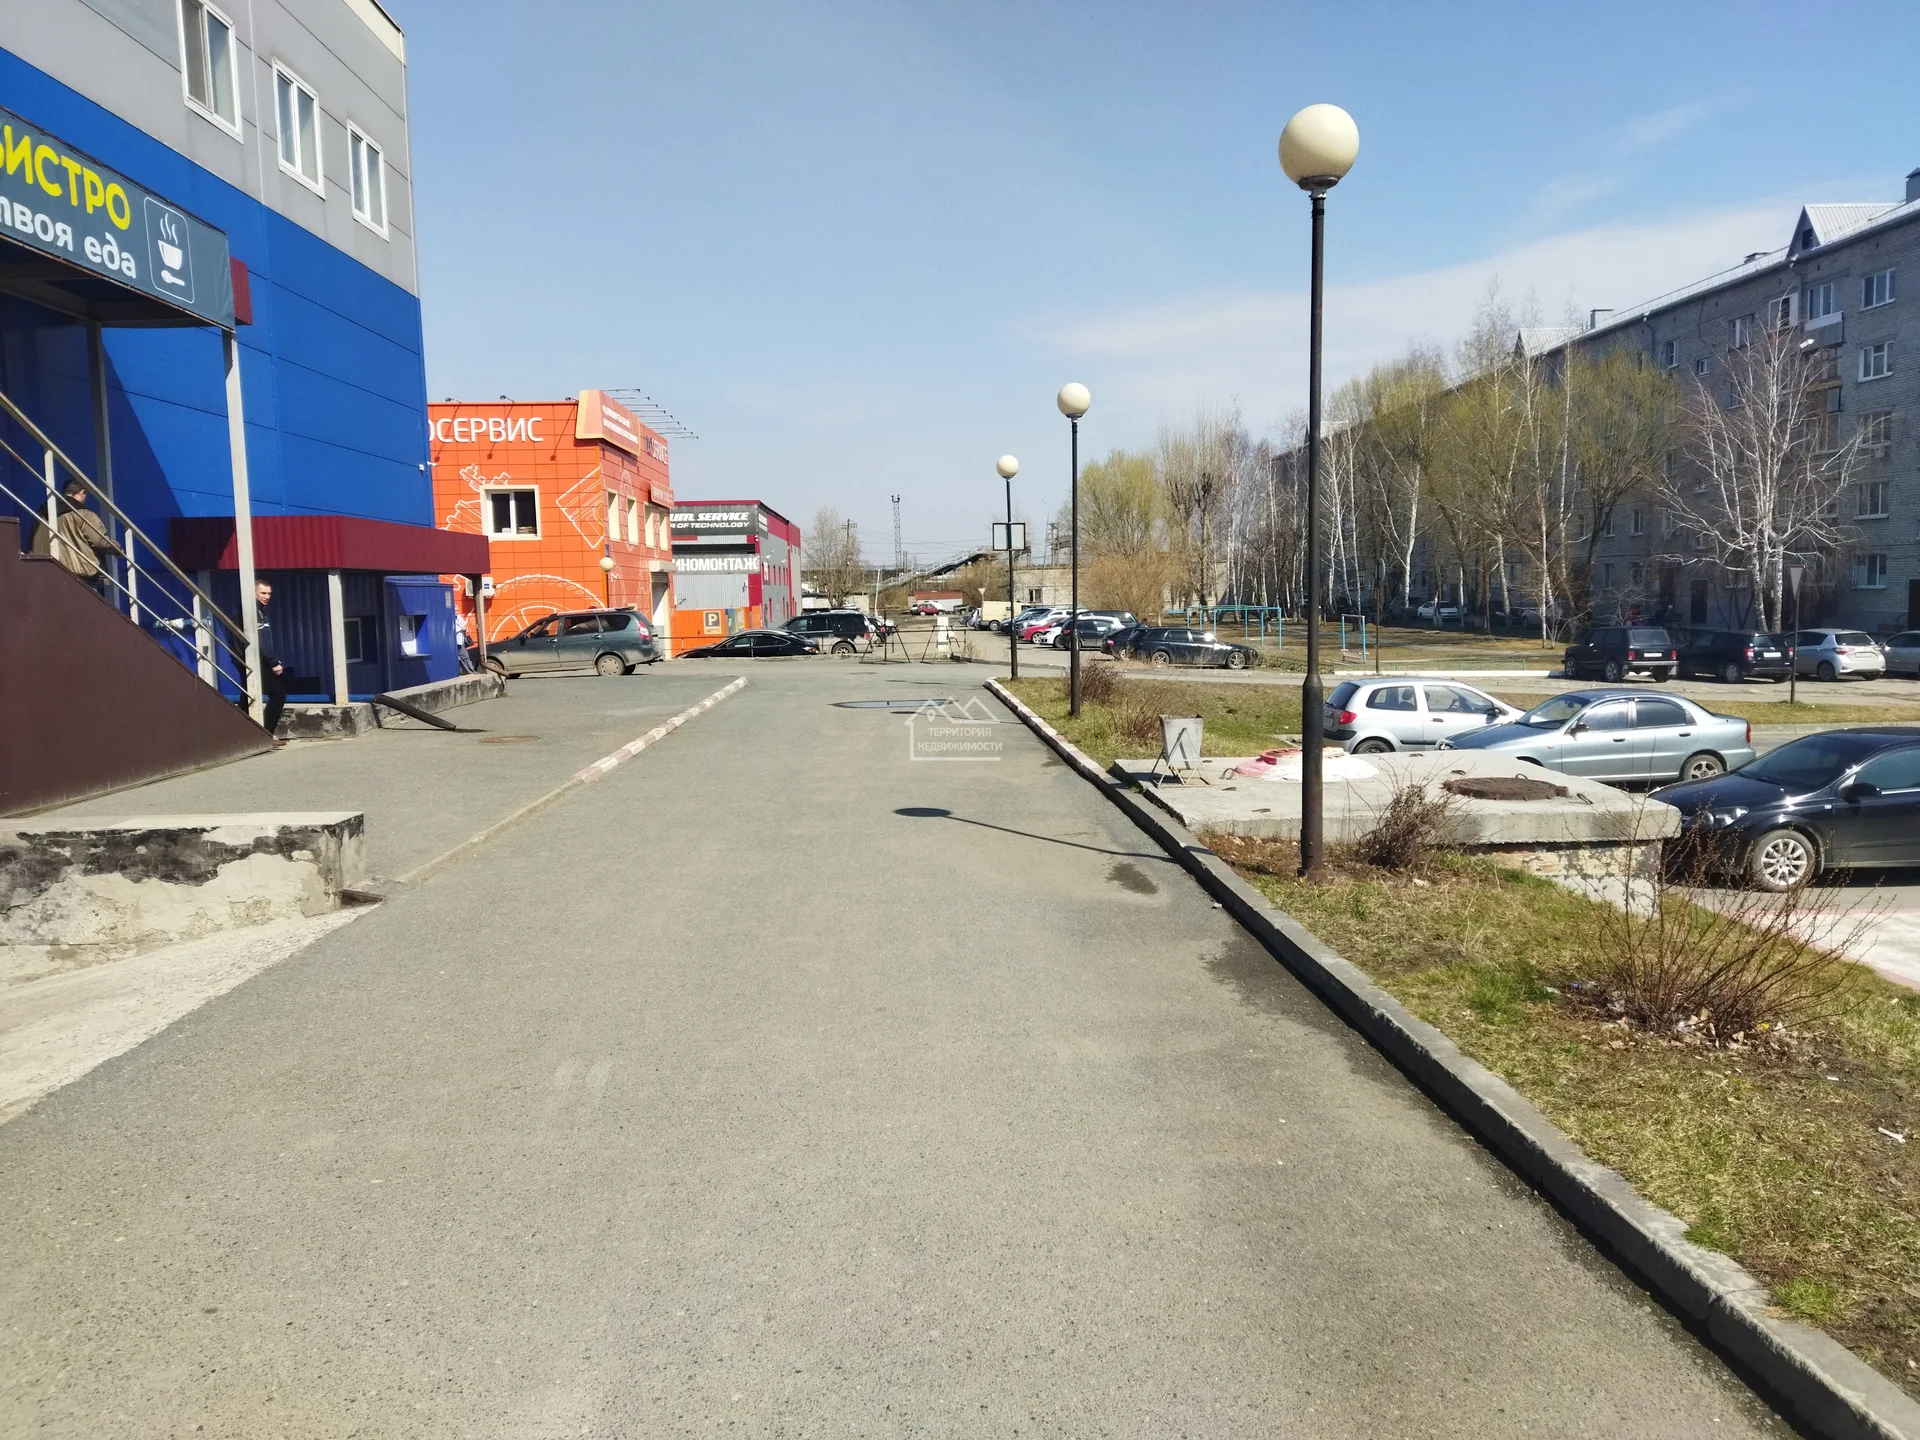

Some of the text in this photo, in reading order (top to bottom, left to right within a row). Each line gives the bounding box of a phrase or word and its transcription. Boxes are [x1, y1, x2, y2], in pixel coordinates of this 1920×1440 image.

[0, 124, 131, 230] ИСТРО
[84, 232, 136, 279] еда
[697, 512, 749, 521] SERVICE
